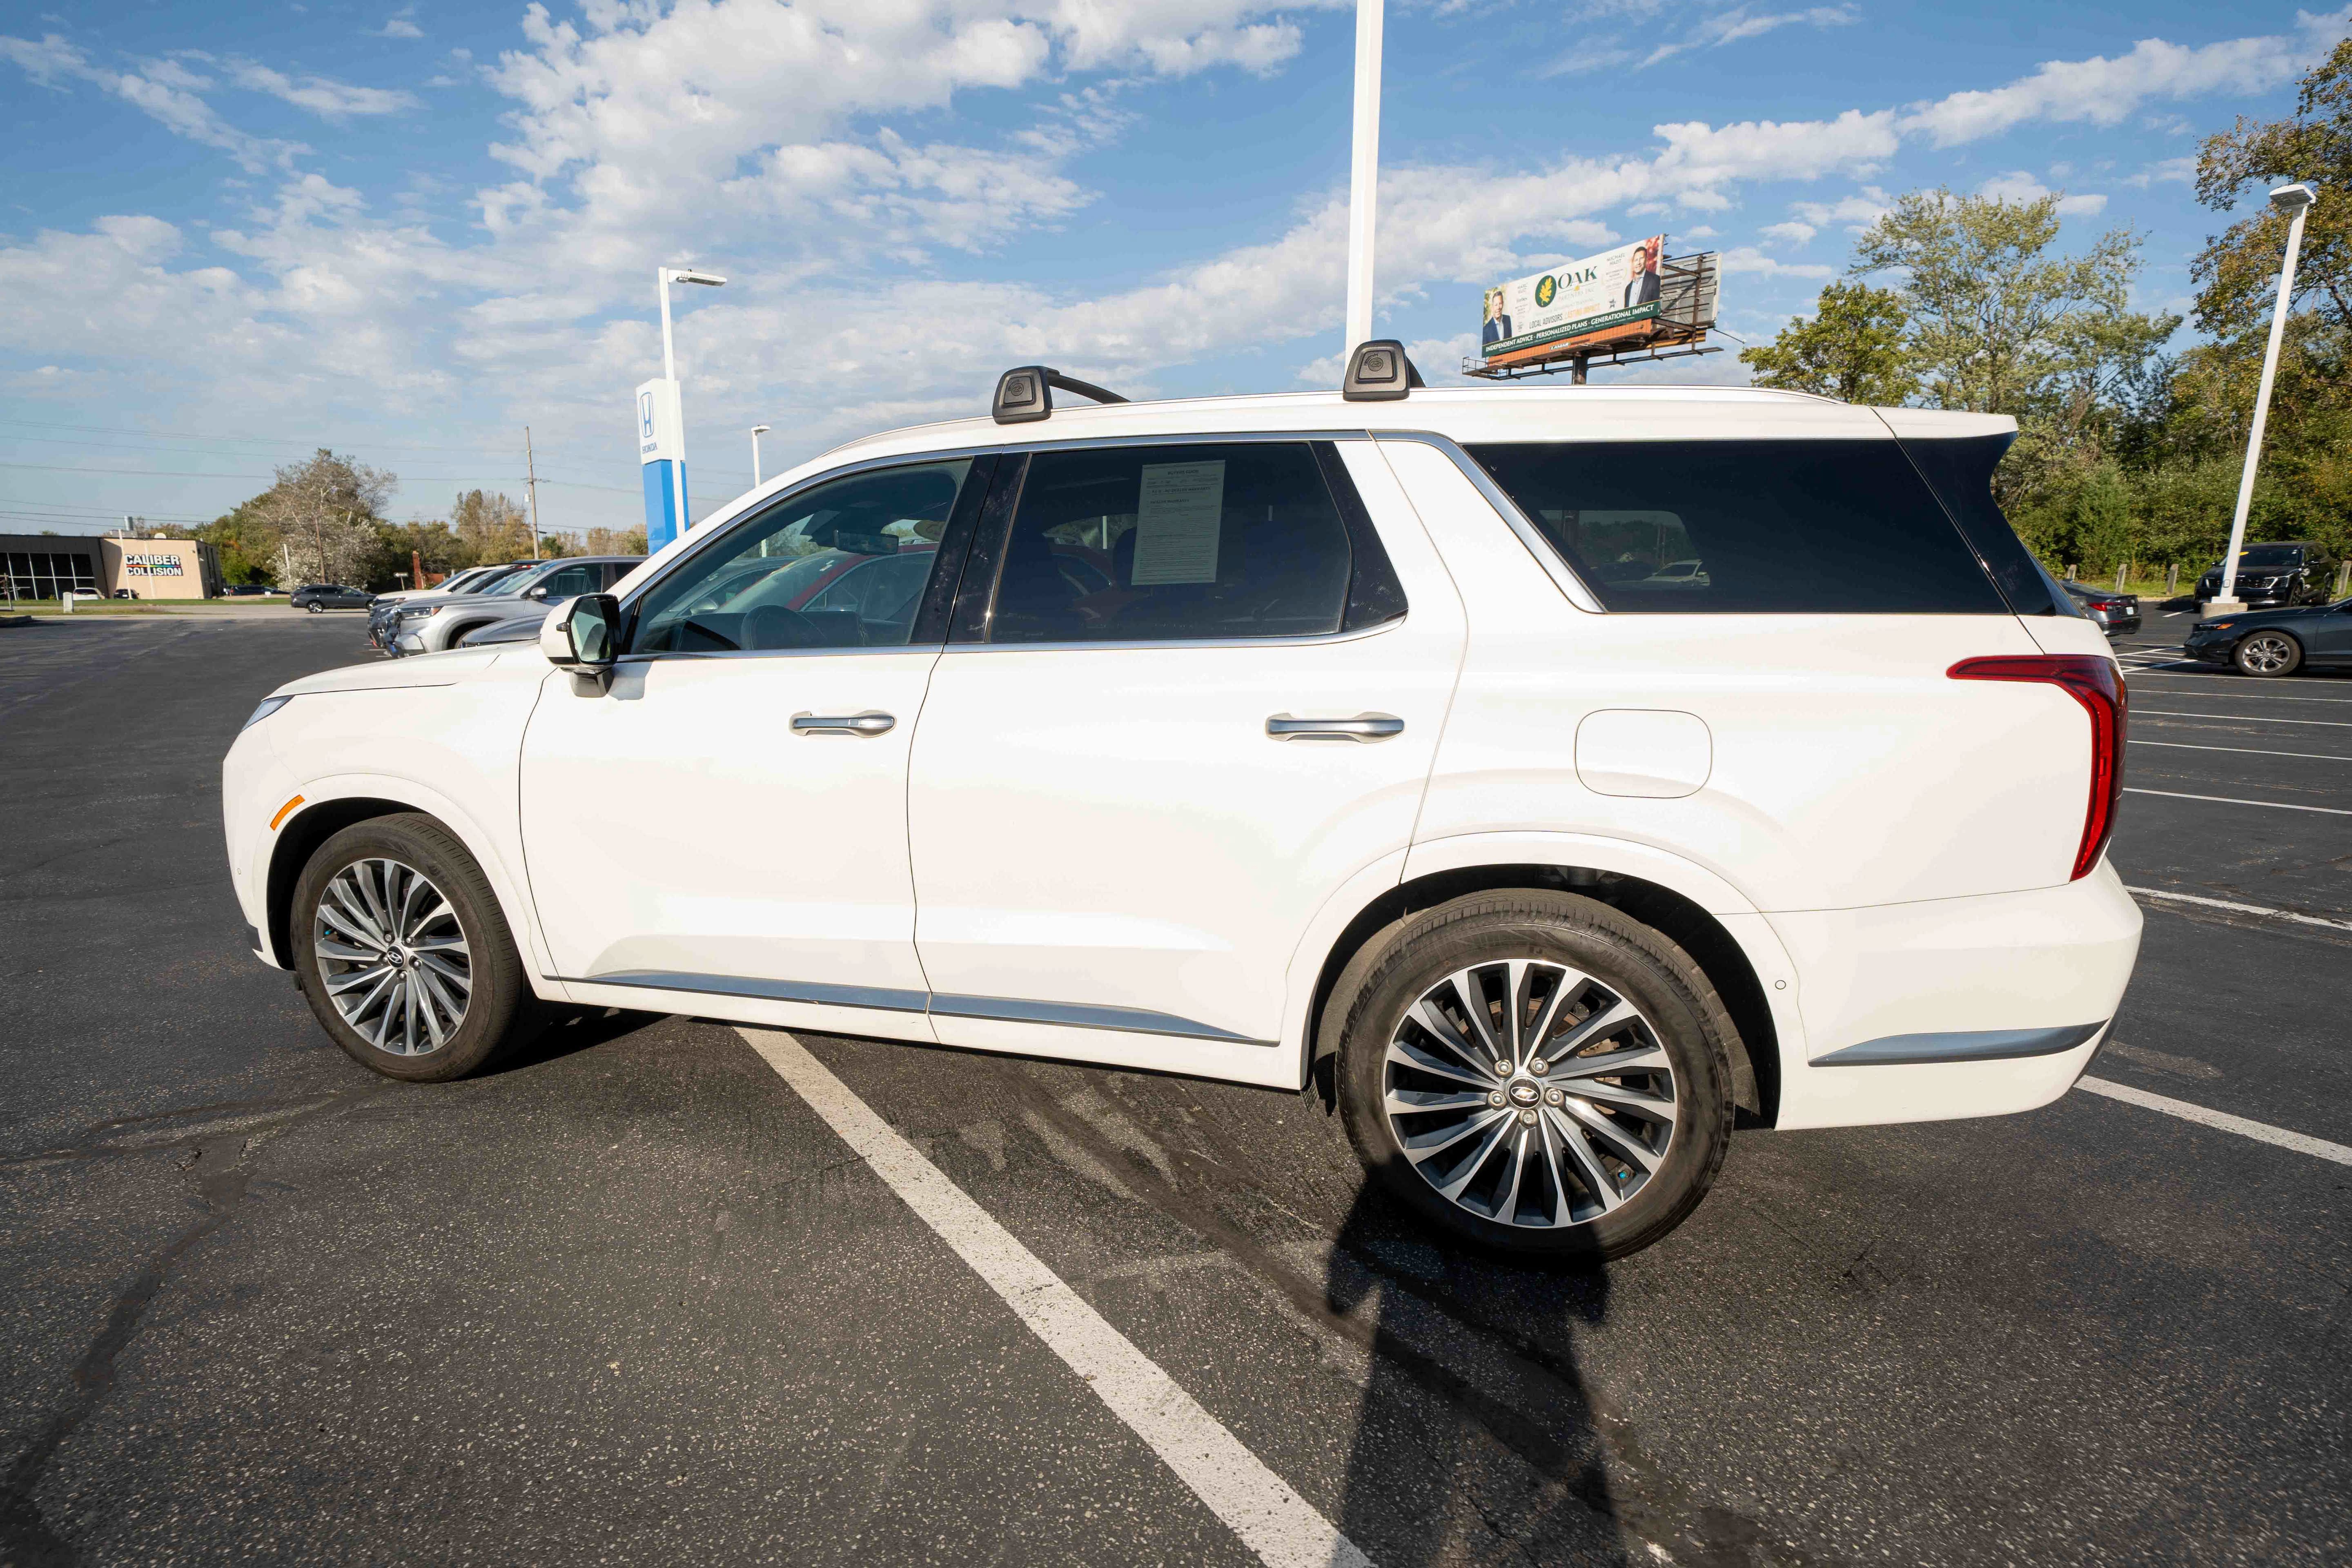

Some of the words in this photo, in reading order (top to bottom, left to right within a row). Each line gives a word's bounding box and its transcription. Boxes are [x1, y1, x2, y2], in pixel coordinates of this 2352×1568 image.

[1558, 266, 1597, 289] OAK
[1486, 339, 1516, 352] INDEPENDENT
[1516, 335, 1533, 344] ADVICE
[1537, 325, 1571, 338] PERSONALIZED
[1572, 321, 1588, 330] PLANS
[1591, 311, 1631, 325] GENERATIONAL
[1632, 305, 1654, 315] IMPACT
[1529, 320, 1541, 329] LOCAL
[642, 442, 658, 454] HONDA
[125, 554, 180, 565] CALIBER
